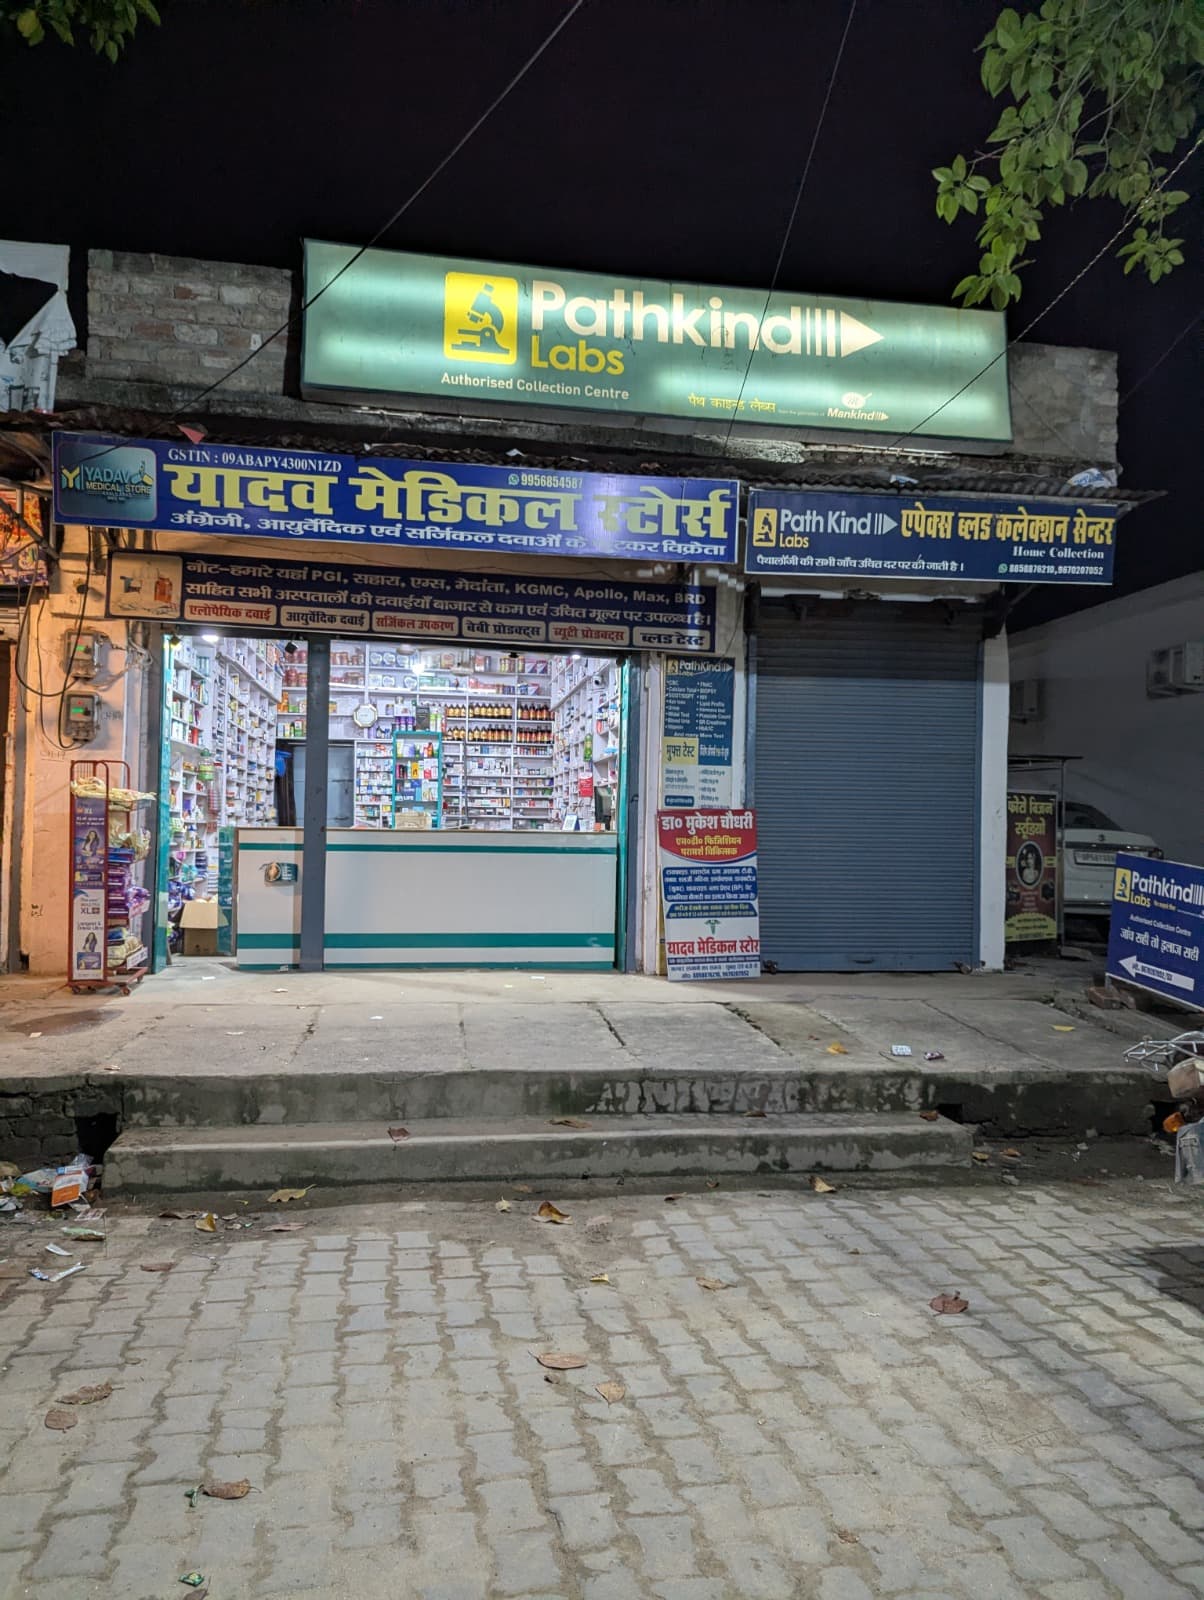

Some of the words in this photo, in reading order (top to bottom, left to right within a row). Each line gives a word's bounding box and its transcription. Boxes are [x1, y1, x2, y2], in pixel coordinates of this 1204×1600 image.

[531, 279, 801, 355] Pathkind
[530, 335, 625, 375] Labs
[441, 372, 514, 390] Authorised
[516, 379, 581, 396] Collection
[584, 385, 629, 400] Centre
[827, 408, 875, 421] Mankind
[168, 448, 211, 463] GSTIN
[85, 466, 130, 483] YADAV
[85, 481, 121, 493] MEDICAL
[125, 484, 151, 494] STORE
[163, 463, 339, 515] यादव
[348, 466, 583, 531] मेडिकल
[592, 483, 732, 539] स्टोर्स
[780, 509, 826, 532] Path
[828, 511, 871, 535] Kind
[900, 501, 955, 539] एपेक्स
[957, 511, 993, 541] ब्लड
[993, 505, 1072, 545] कलेक्शन
[1073, 508, 1116, 546] सेन्टर
[170, 510, 251, 529] अंग्रेजी,
[257, 517, 365, 535] आयुर्वेदिक
[370, 524, 402, 537] एवं
[405, 525, 496, 543] सर्जिकल
[497, 533, 562, 547] दवाओं
[565, 536, 587, 549] के
[661, 539, 727, 556] विक्रेता
[779, 531, 809, 548] Labs
[1013, 546, 1046, 558] Home
[1049, 547, 1104, 559] Collection
[800, 555, 814, 567] की
[815, 556, 836, 567] सभी
[858, 557, 882, 569] उचित
[883, 560, 897, 570] दर
[898, 561, 911, 570] पर
[911, 558, 925, 571] की
[926, 560, 949, 571] जाती
[311, 570, 349, 584] PGI,
[515, 583, 569, 599] KGMC,
[574, 587, 628, 602] Apollo,
[633, 590, 670, 605] Max,
[674, 592, 706, 605] BRD
[238, 585, 272, 600] सभी
[274, 589, 348, 604] अस्पतालों
[350, 591, 373, 606] की
[433, 599, 477, 612] बाजार
[479, 601, 492, 614] से
[495, 603, 524, 616] कम
[527, 603, 548, 616] एवं
[550, 603, 586, 618] उचित
[588, 608, 620, 623] मूल्य
[623, 610, 642, 622] पर
[644, 611, 692, 624] उपलब्ध
[245, 607, 272, 621] दवाई
[286, 610, 337, 625] आयुर्वेदिक
[340, 613, 365, 627] दवाई
[376, 615, 416, 629] सर्जिकल
[418, 618, 454, 632] उपकरण
[672, 631, 705, 646] टेस्ट
[684, 812, 719, 835] मुकेश
[720, 811, 754, 829] चौधरी
[1132, 871, 1193, 903] Pathkind
[1130, 890, 1151, 908] Labs
[667, 941, 695, 955] यादव
[697, 936, 737, 954] मेडिकल
[739, 935, 760, 953] स्टोर
[1135, 931, 1149, 946] सही
[1150, 934, 1159, 949] तो
[1161, 939, 1182, 956] इलाज
[1183, 945, 1200, 961] सही
